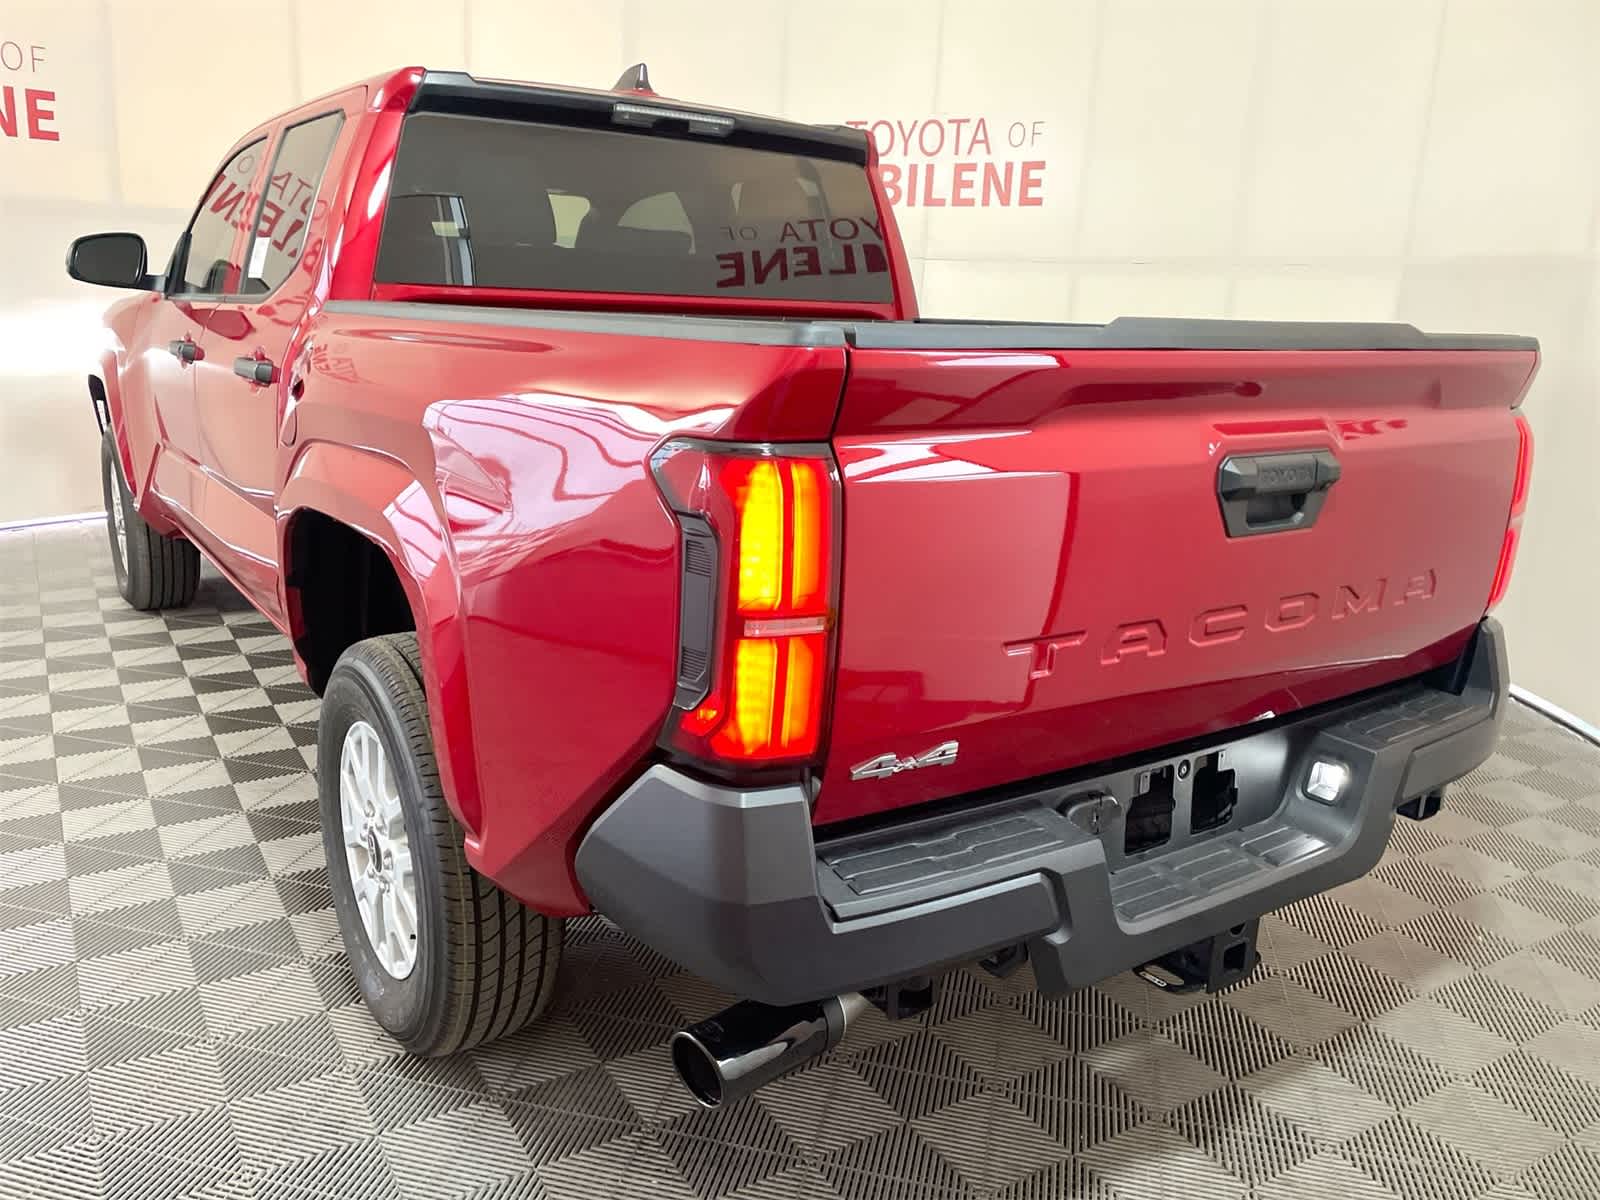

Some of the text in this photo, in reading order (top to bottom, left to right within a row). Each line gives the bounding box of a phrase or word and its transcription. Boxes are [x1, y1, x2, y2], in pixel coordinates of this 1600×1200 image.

[1, 41, 46, 73] OF
[1008, 121, 1045, 148] OF
[1002, 568, 1438, 681] TACOMA
